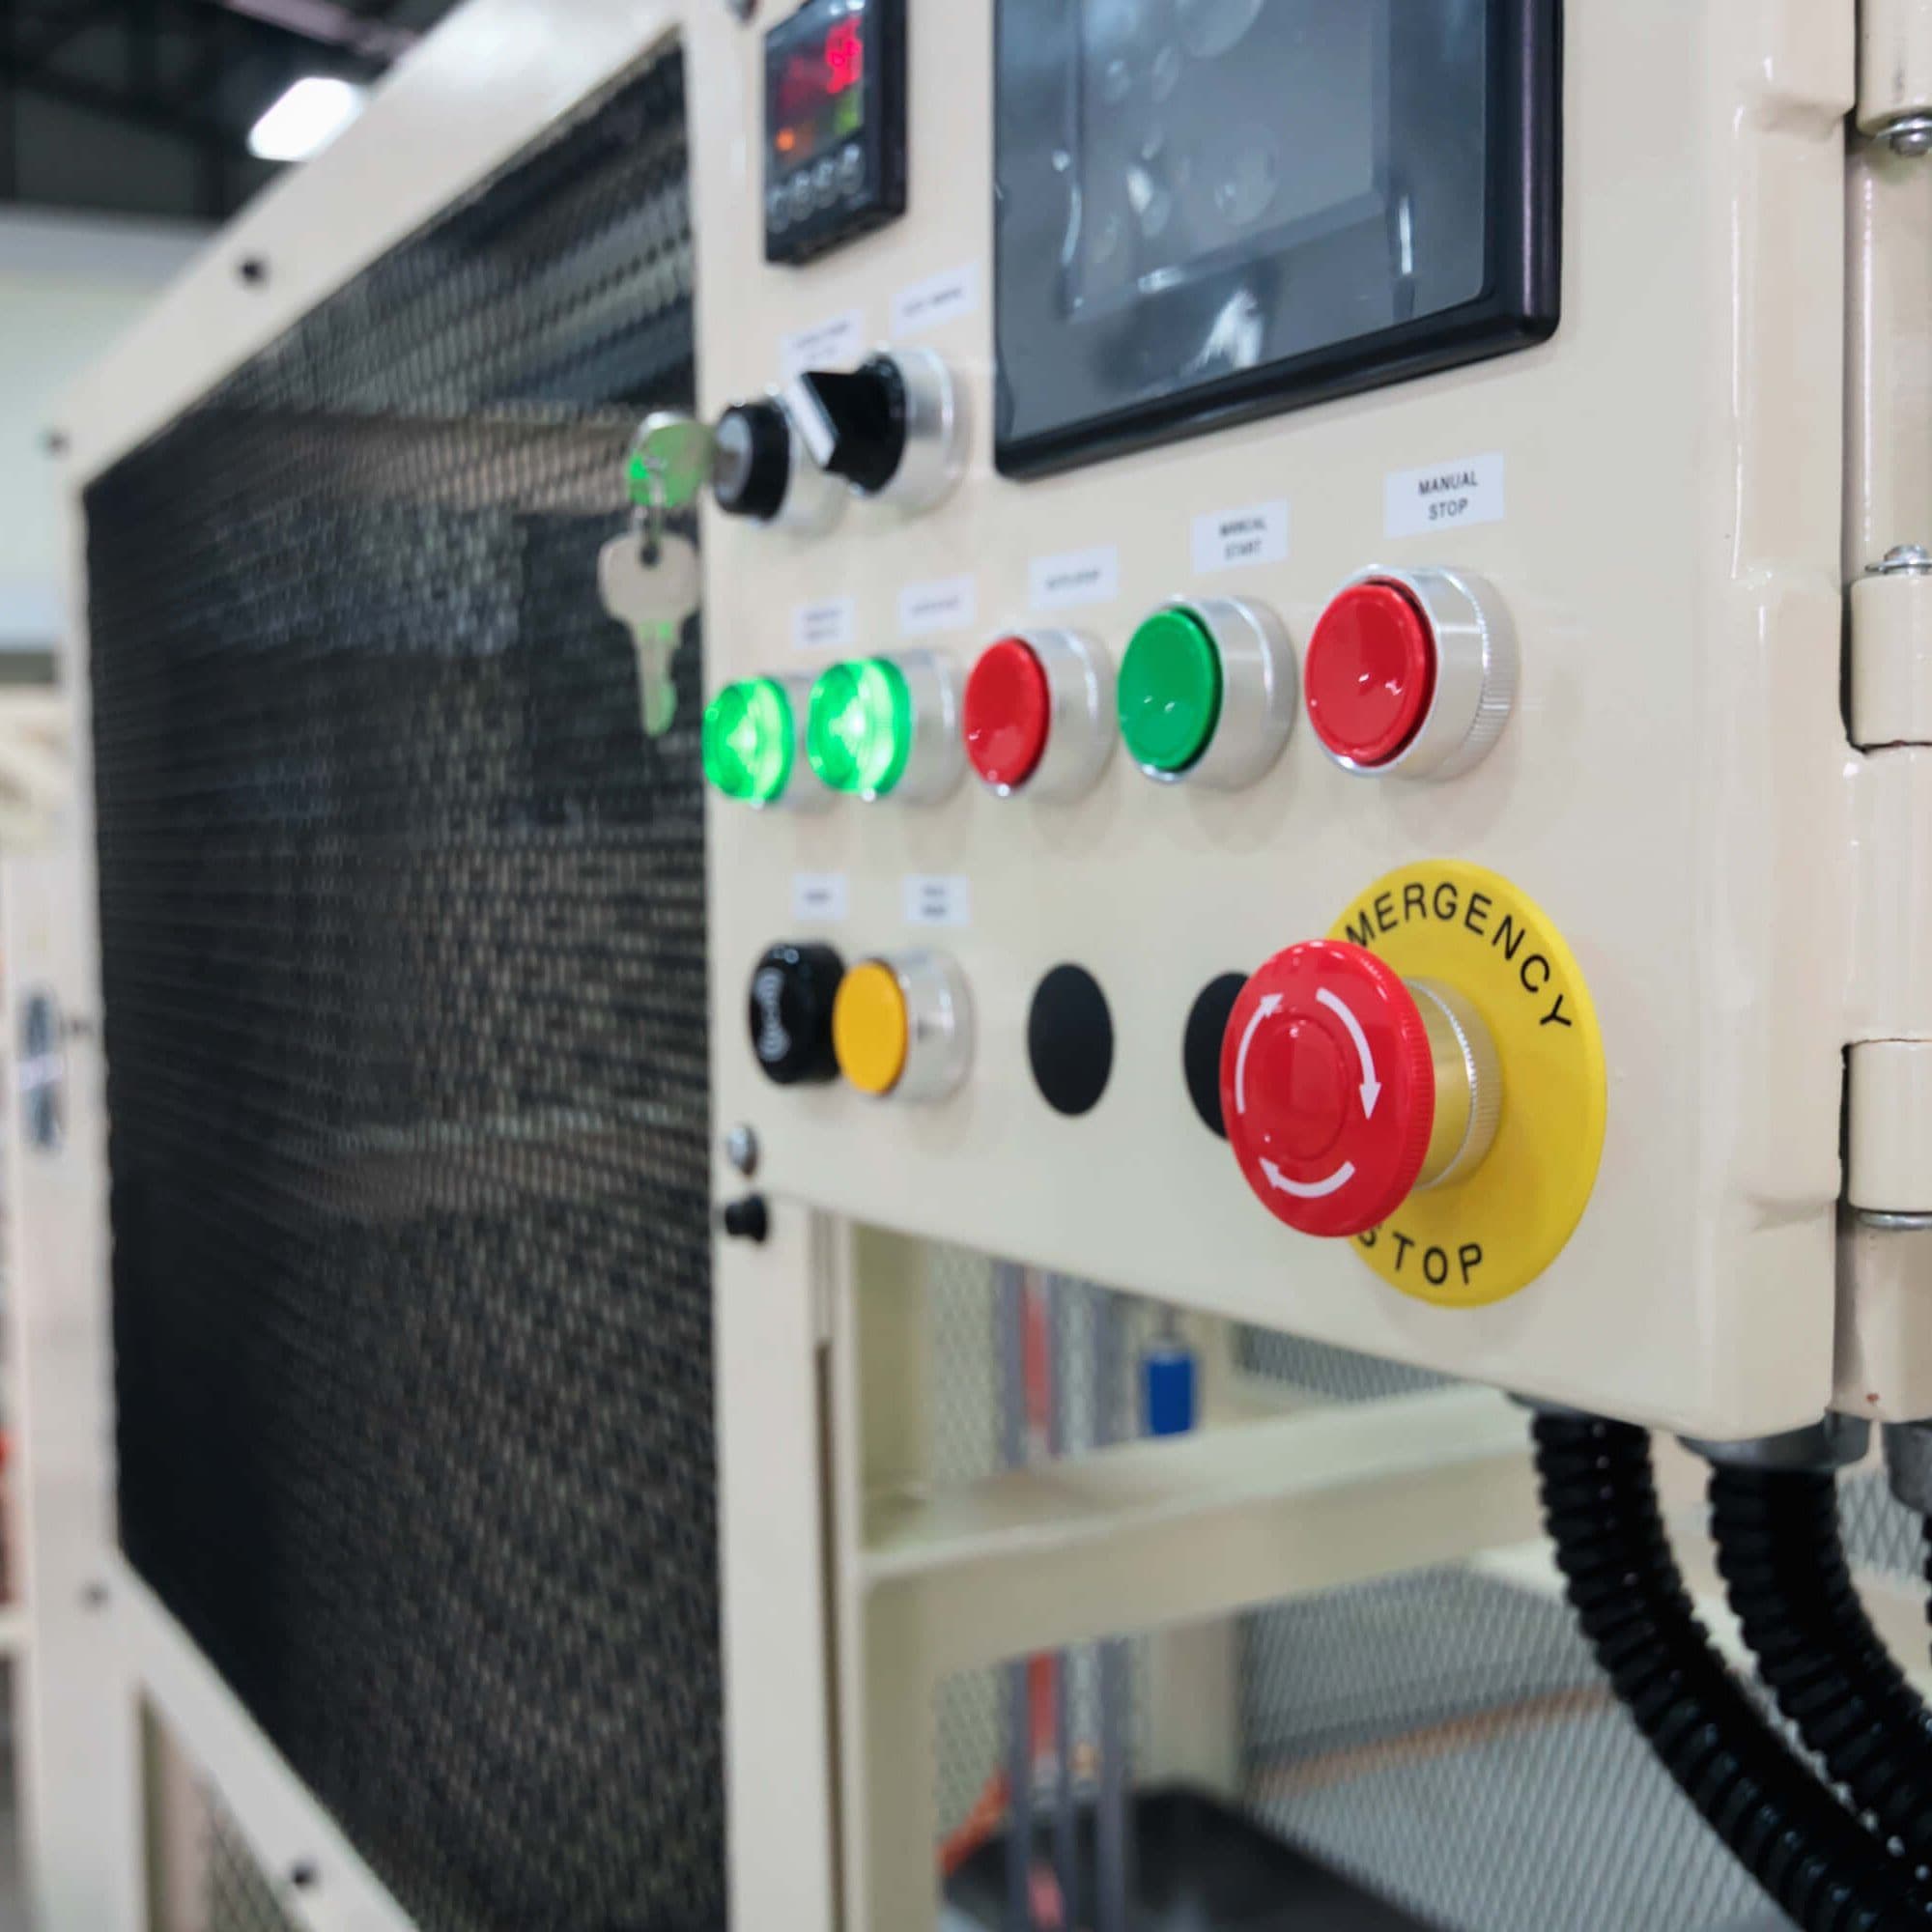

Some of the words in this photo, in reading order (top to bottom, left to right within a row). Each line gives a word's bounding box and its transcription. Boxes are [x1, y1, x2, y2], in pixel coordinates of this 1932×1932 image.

[1417, 470, 1478, 495] MANUAL
[1428, 497, 1468, 521] STOP
[1345, 881, 1573, 1029] MERGENCY
